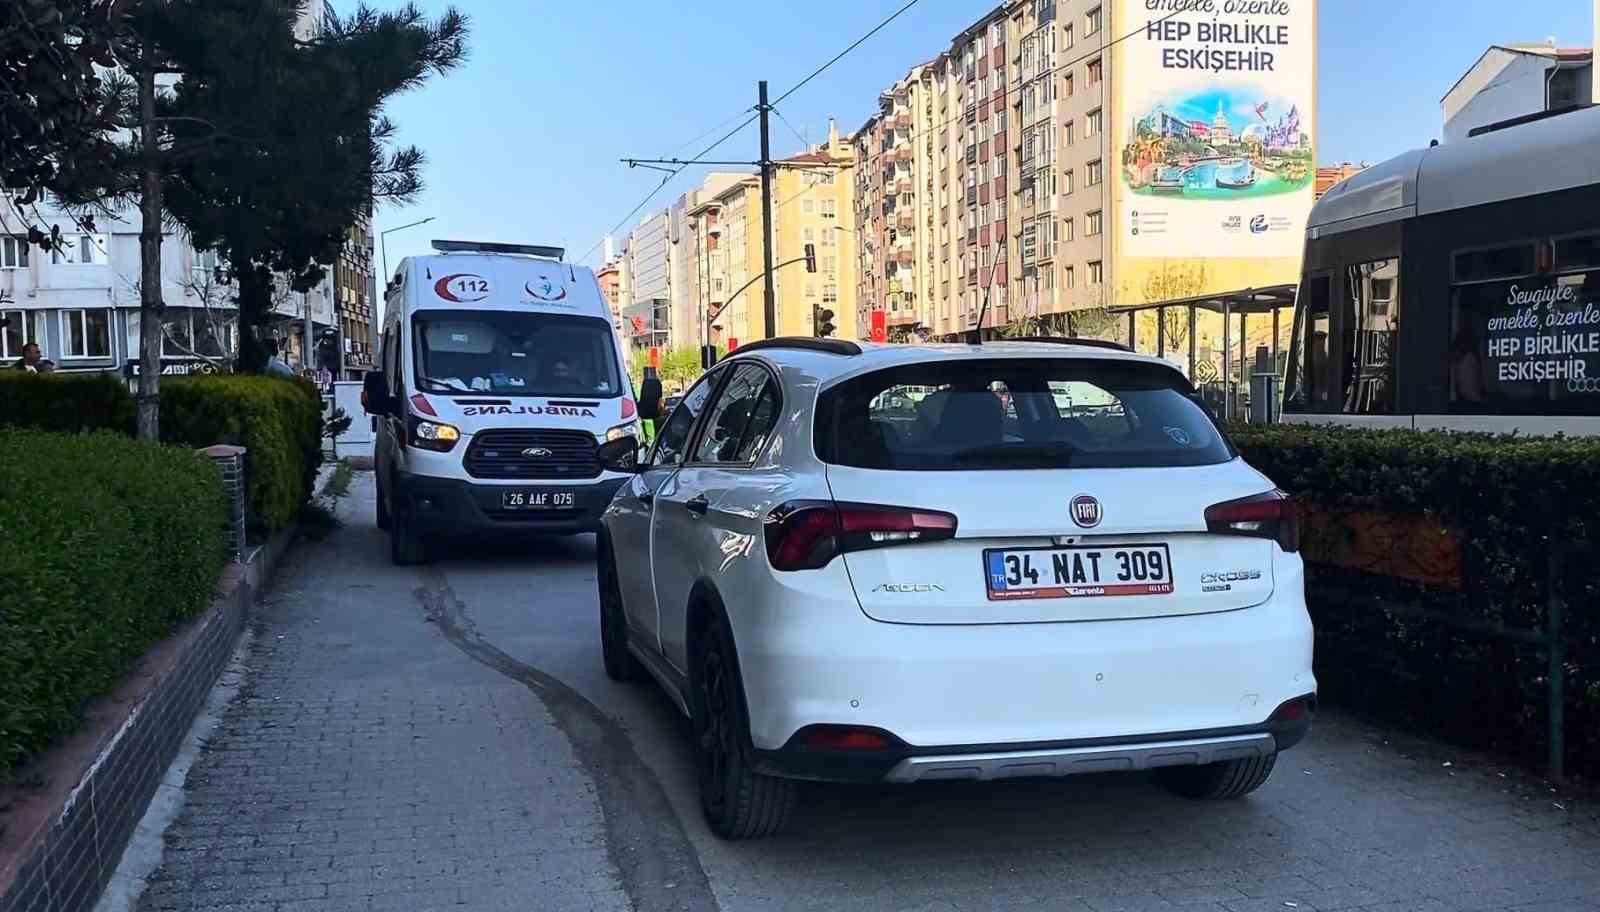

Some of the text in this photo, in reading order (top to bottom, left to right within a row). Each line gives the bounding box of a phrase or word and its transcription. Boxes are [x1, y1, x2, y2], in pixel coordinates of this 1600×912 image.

[1147, 18, 1289, 45] HEP BİRLİKLE
[1162, 45, 1274, 73] ESKİŞEHİR
[458, 280, 488, 292] 112
[1488, 330, 1600, 357] HEP BİRLİKLE
[1498, 355, 1586, 382] ESKİŞEHİR
[510, 493, 572, 505] 26 AAF 075
[1077, 503, 1096, 519] FIAT
[994, 574, 1006, 584] TR
[1005, 550, 1164, 586] 34 NAT 309
